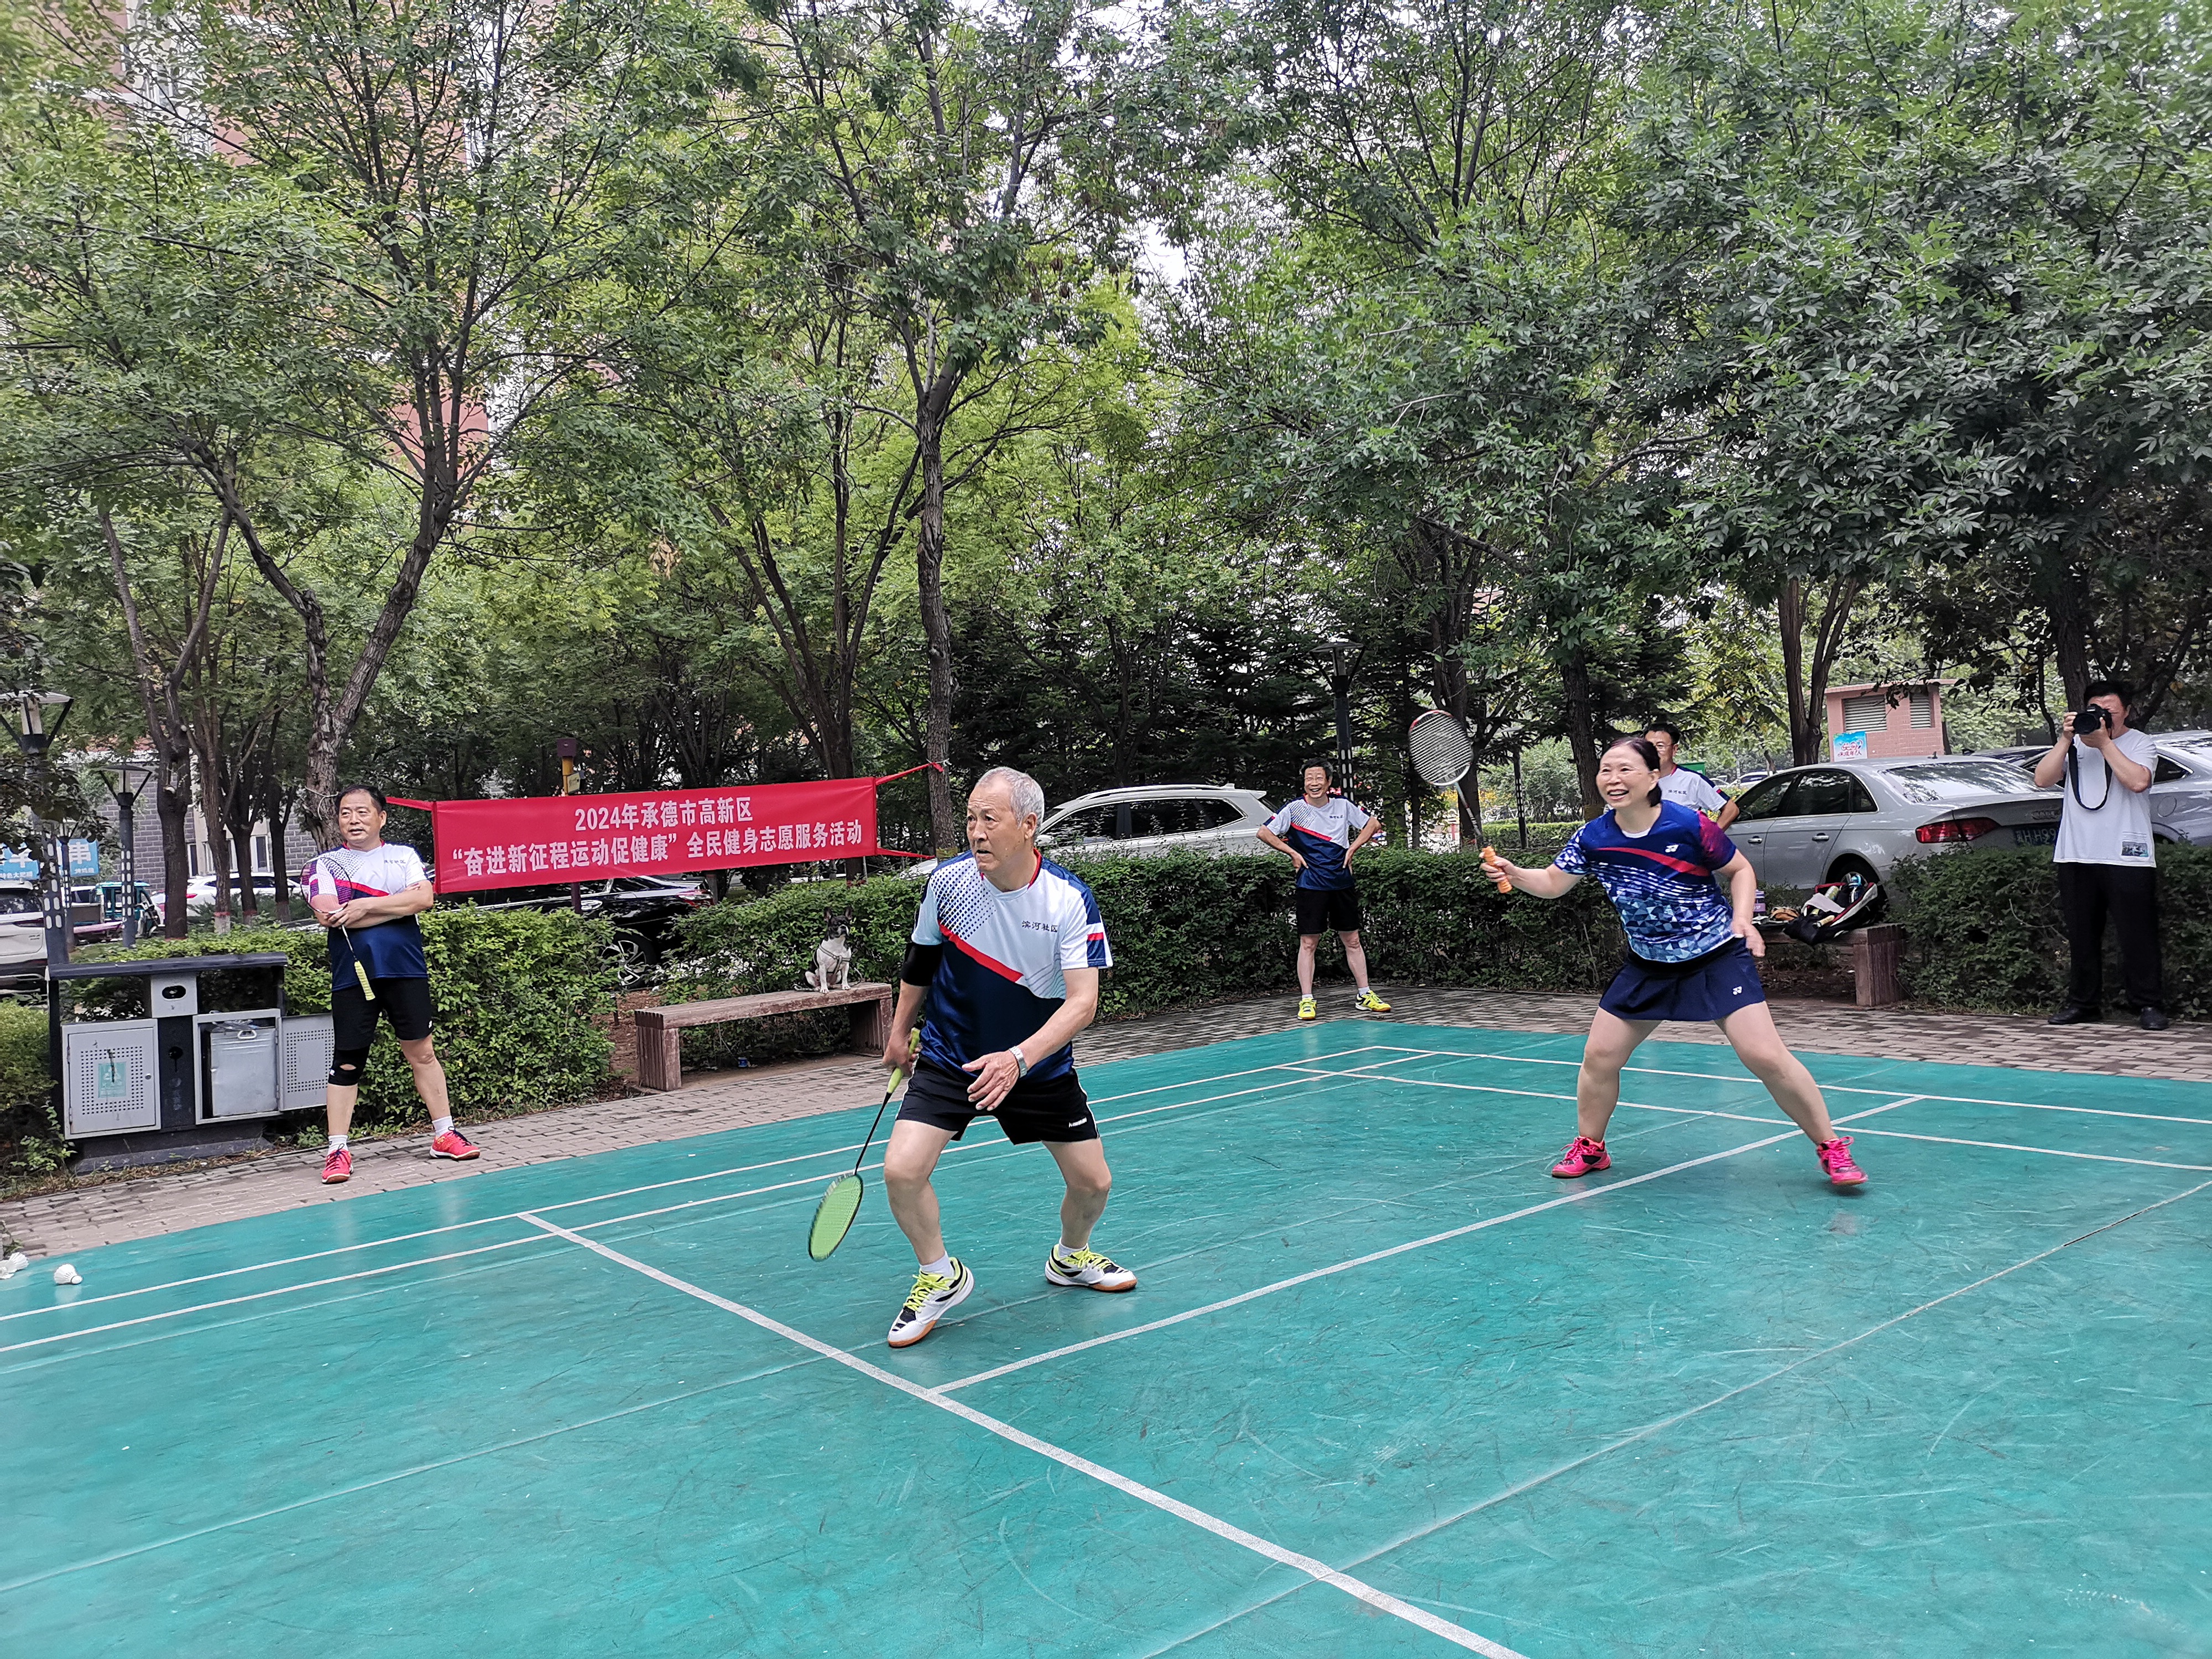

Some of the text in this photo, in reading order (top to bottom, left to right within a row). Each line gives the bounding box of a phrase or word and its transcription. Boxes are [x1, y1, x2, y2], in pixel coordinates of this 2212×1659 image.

[575, 796, 753, 831] 2024年承德市高新区
[1021, 920, 1058, 932] 滨河社区
